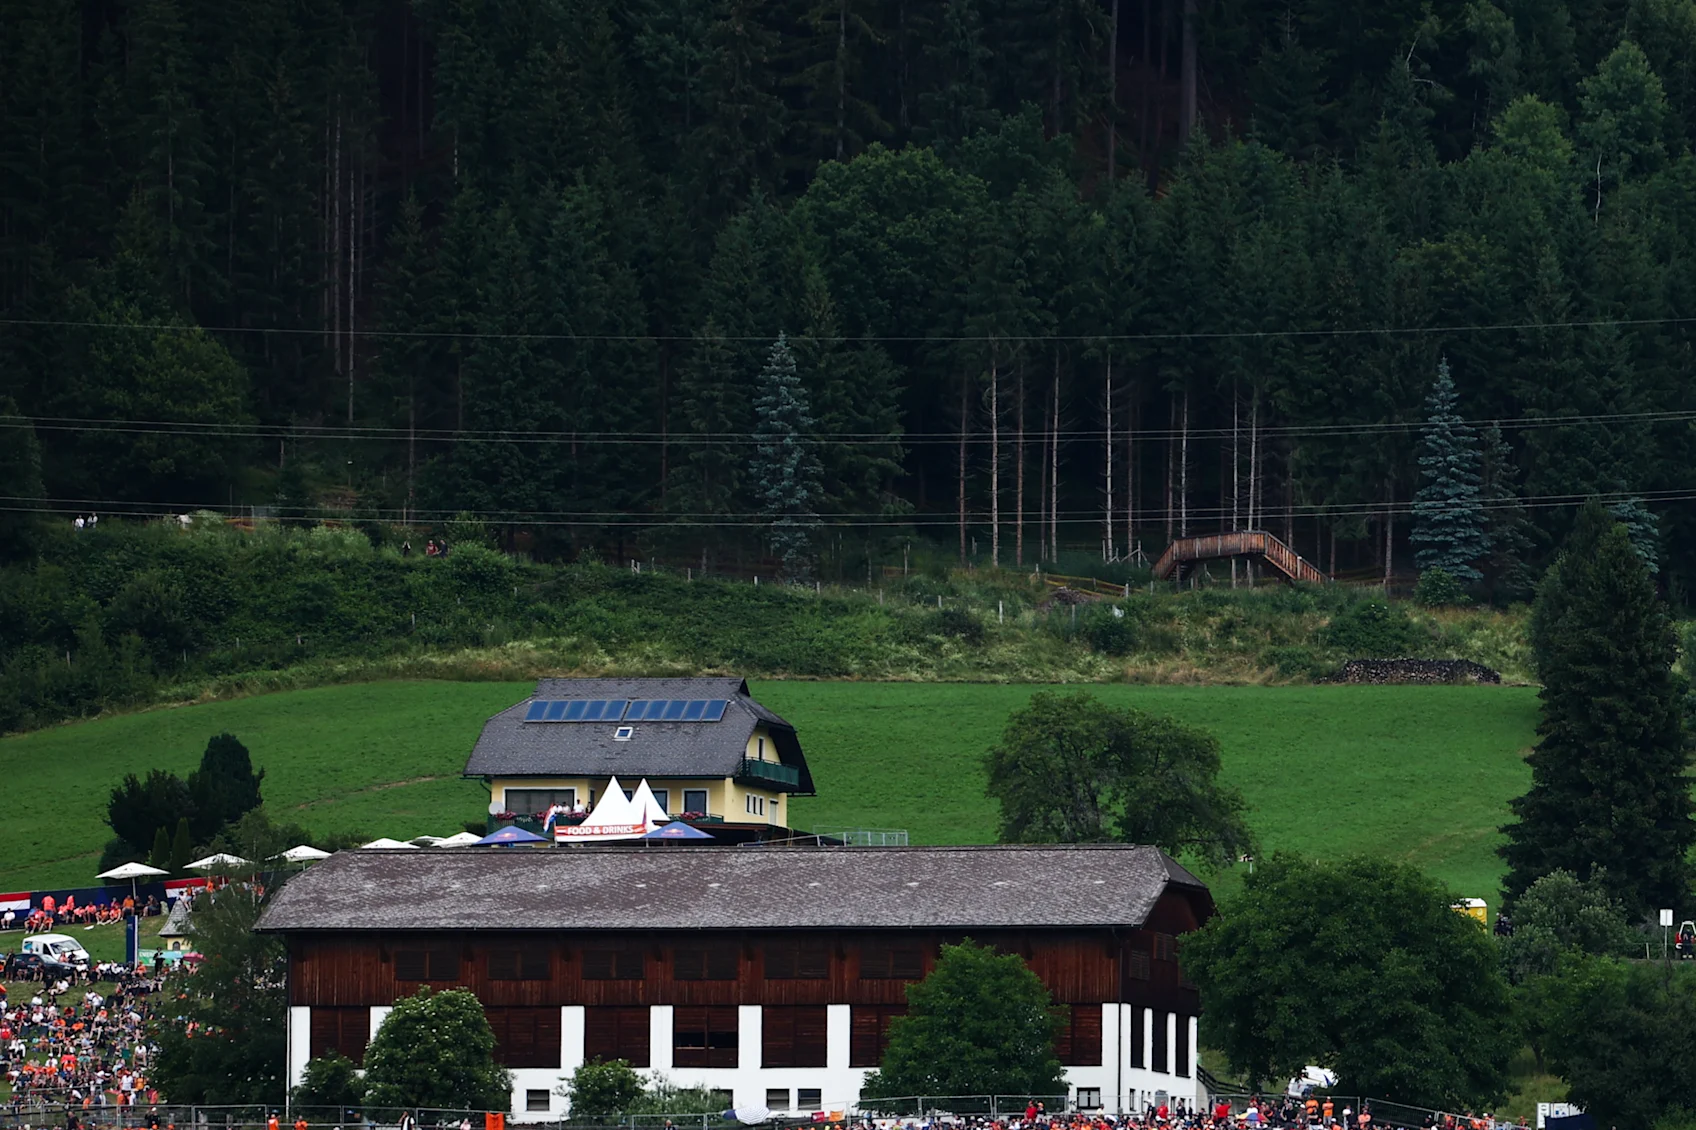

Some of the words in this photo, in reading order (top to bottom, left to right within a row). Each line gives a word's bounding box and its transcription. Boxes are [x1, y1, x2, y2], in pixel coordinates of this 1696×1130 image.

[567, 827, 592, 835] FOOD
[592, 826, 600, 834] &
[602, 825, 634, 834] DRINKS
